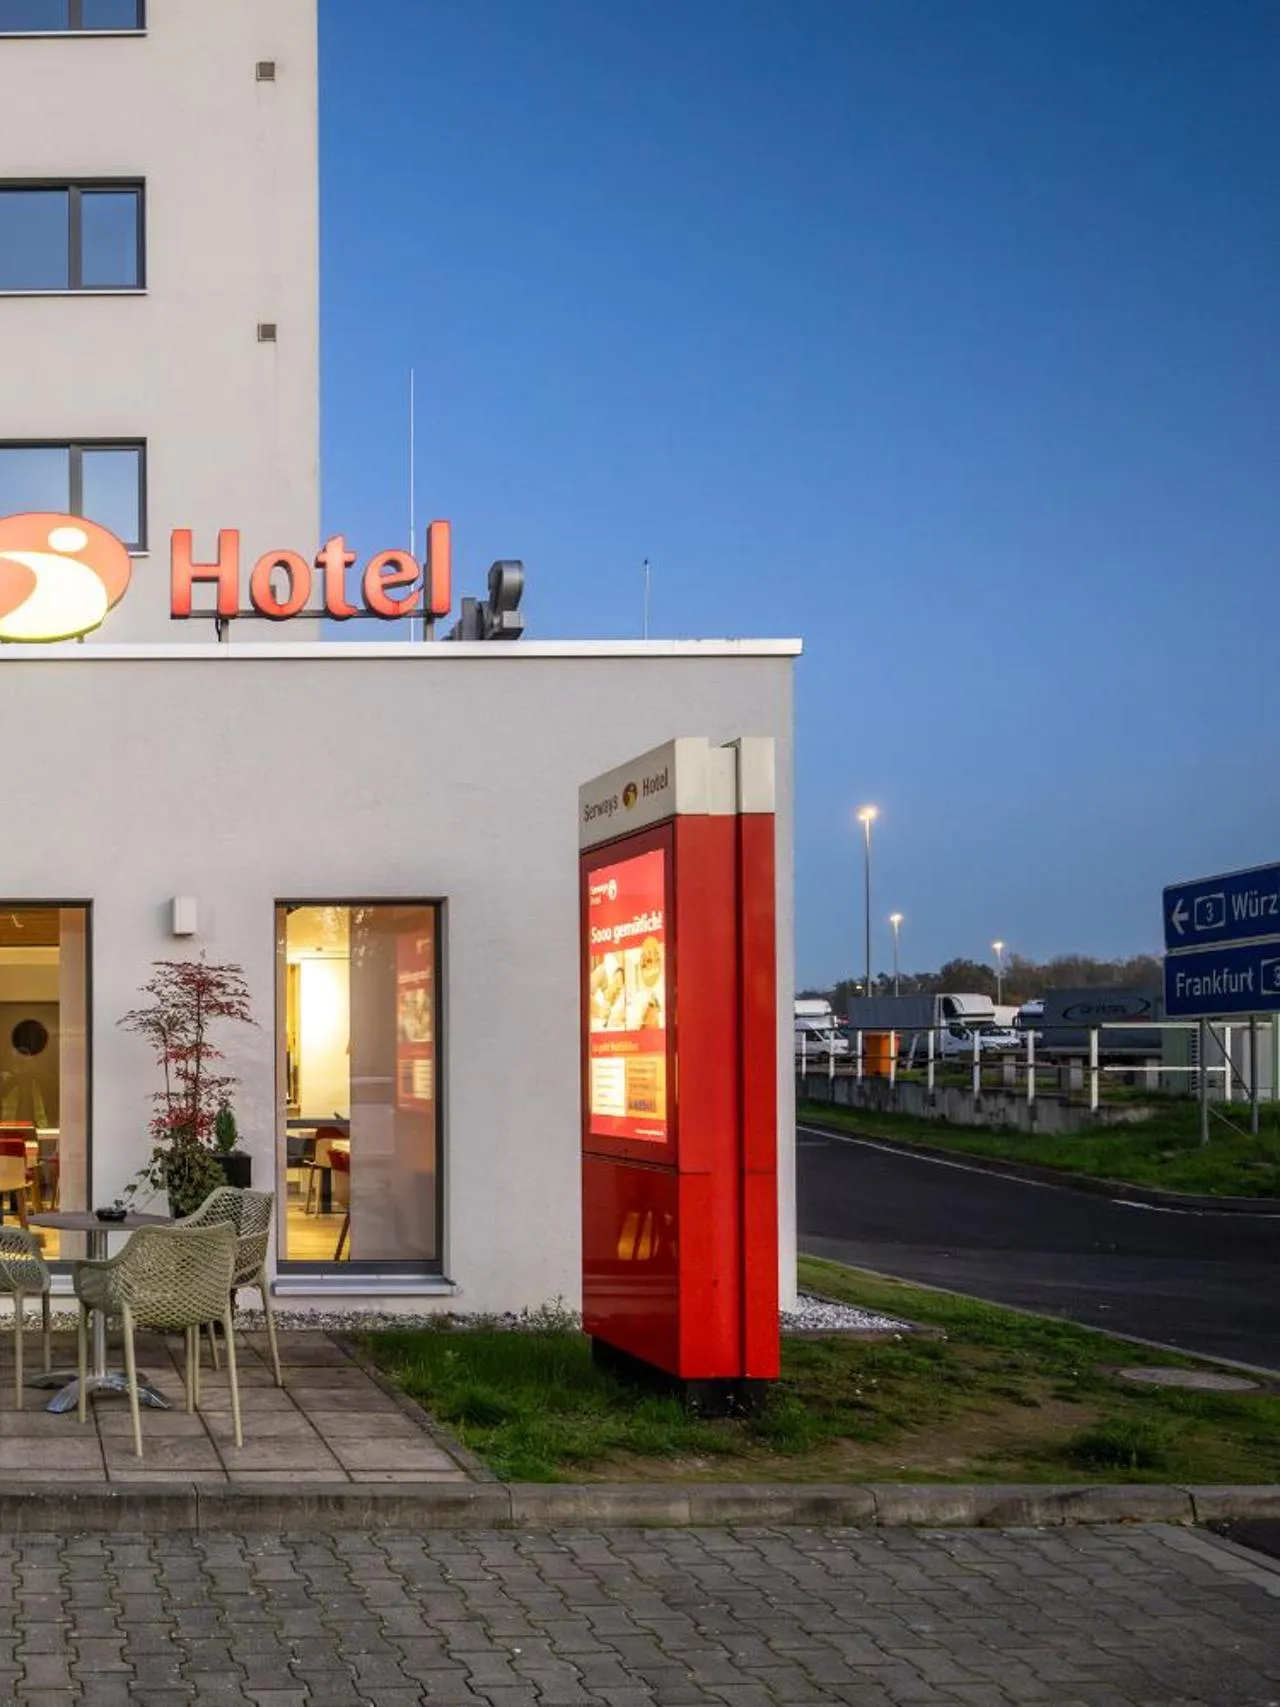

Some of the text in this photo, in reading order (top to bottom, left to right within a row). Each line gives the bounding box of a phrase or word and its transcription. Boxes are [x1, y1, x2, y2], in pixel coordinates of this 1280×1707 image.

[169, 520, 452, 619] Hotel
[583, 766, 668, 822] Serways Hotel
[1206, 890, 1279, 922] 3 Würz
[1176, 967, 1254, 998] Frankfurt
